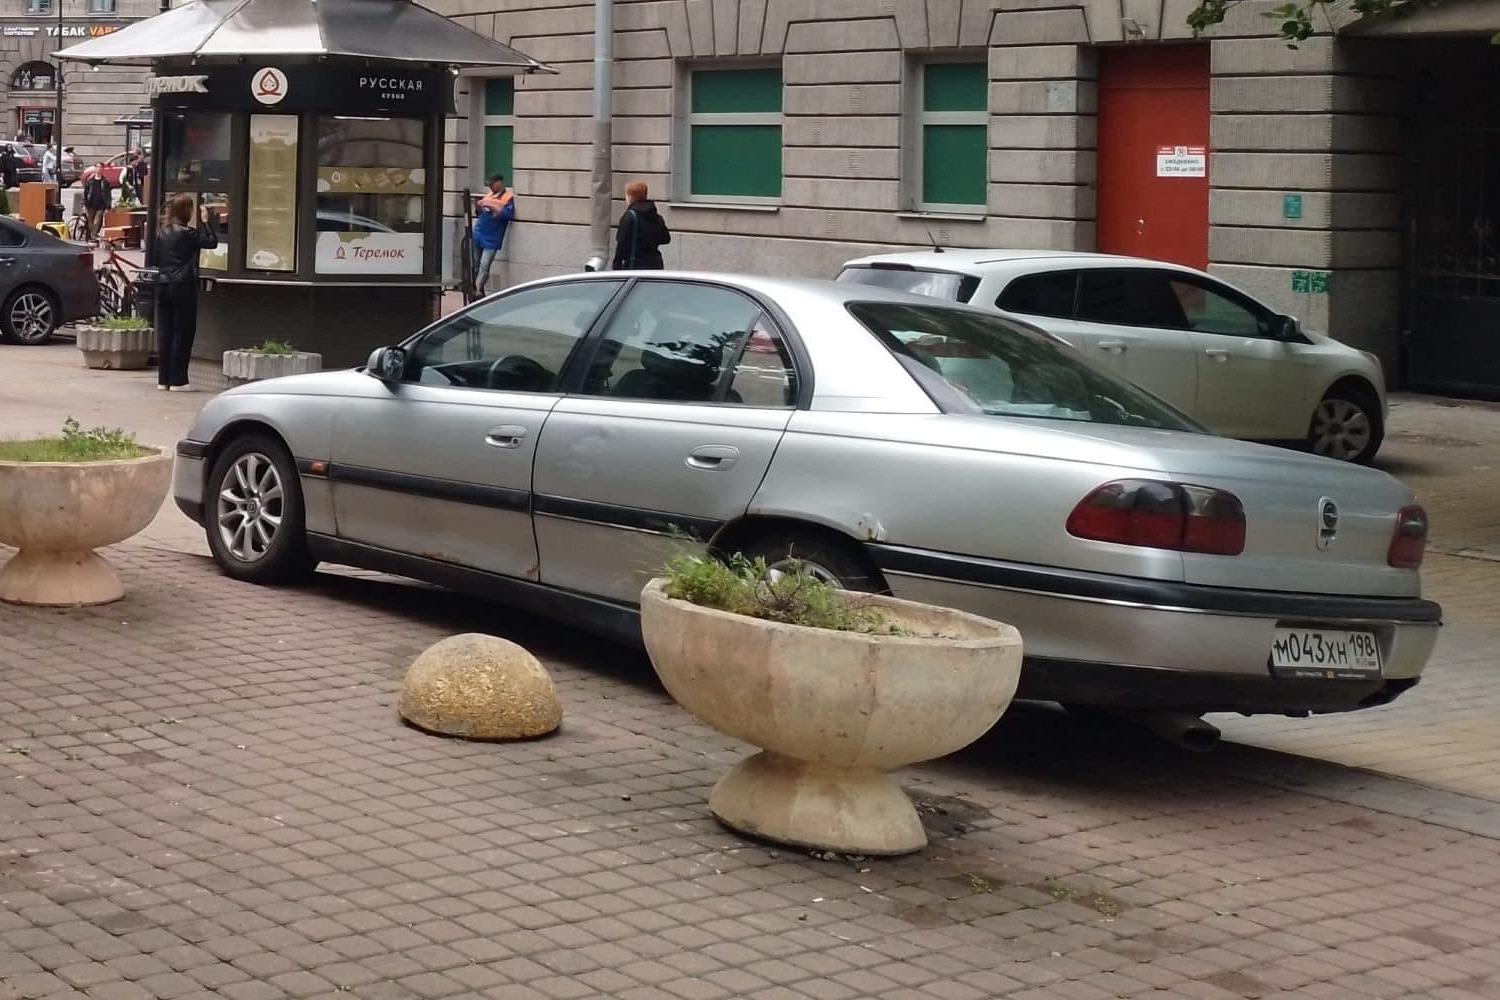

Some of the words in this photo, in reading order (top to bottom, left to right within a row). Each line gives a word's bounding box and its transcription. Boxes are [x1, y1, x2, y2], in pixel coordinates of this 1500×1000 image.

[45, 26, 85, 36] ТАБАК
[360, 77, 423, 91] РУССКАЯ
[352, 246, 405, 261] Теремок
[1349, 633, 1375, 657] 198
